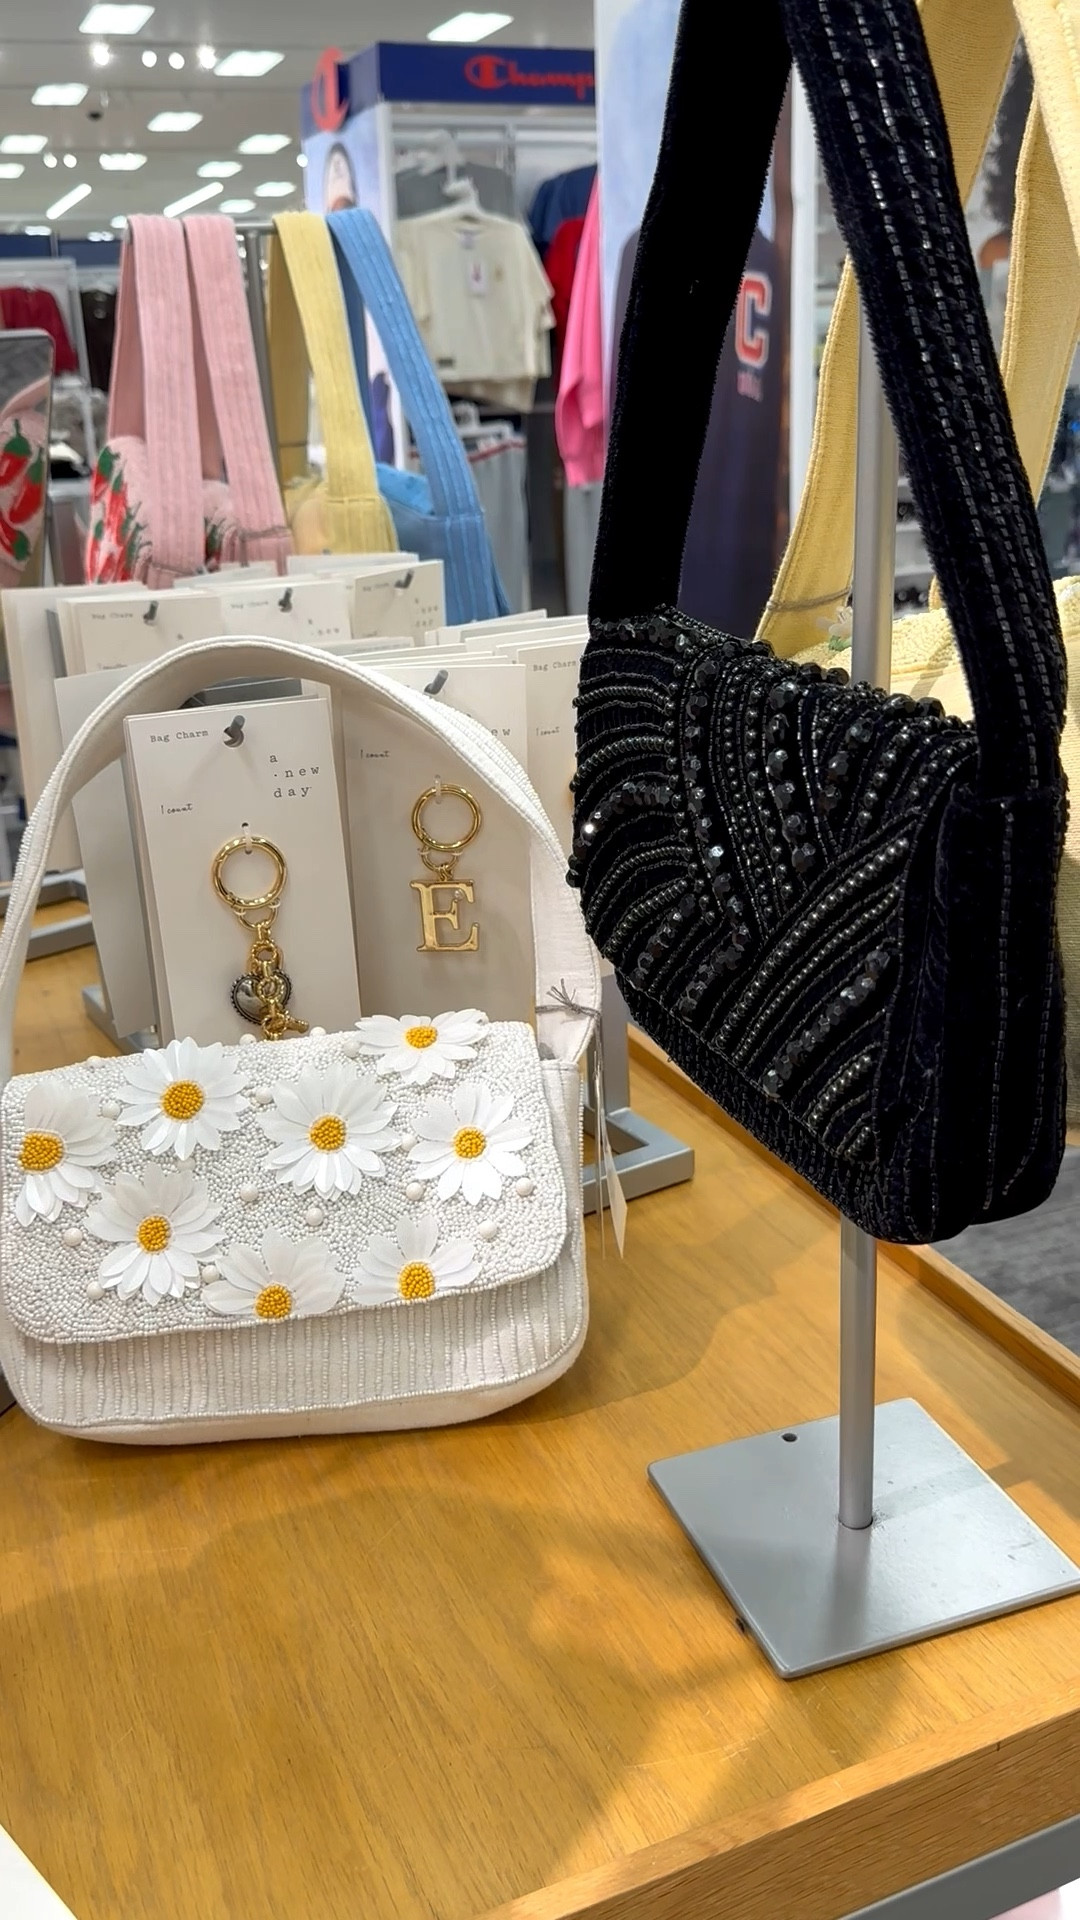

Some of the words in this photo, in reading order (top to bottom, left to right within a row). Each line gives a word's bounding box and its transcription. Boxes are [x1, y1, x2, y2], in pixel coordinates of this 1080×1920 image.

[735, 271, 773, 370] C
[150, 733, 170, 743] Bag
[176, 729, 209, 740] Charm
[269, 754, 278, 763] a
[273, 785, 310, 798] day
[167, 803, 194, 815] count
[409, 880, 479, 952] E
